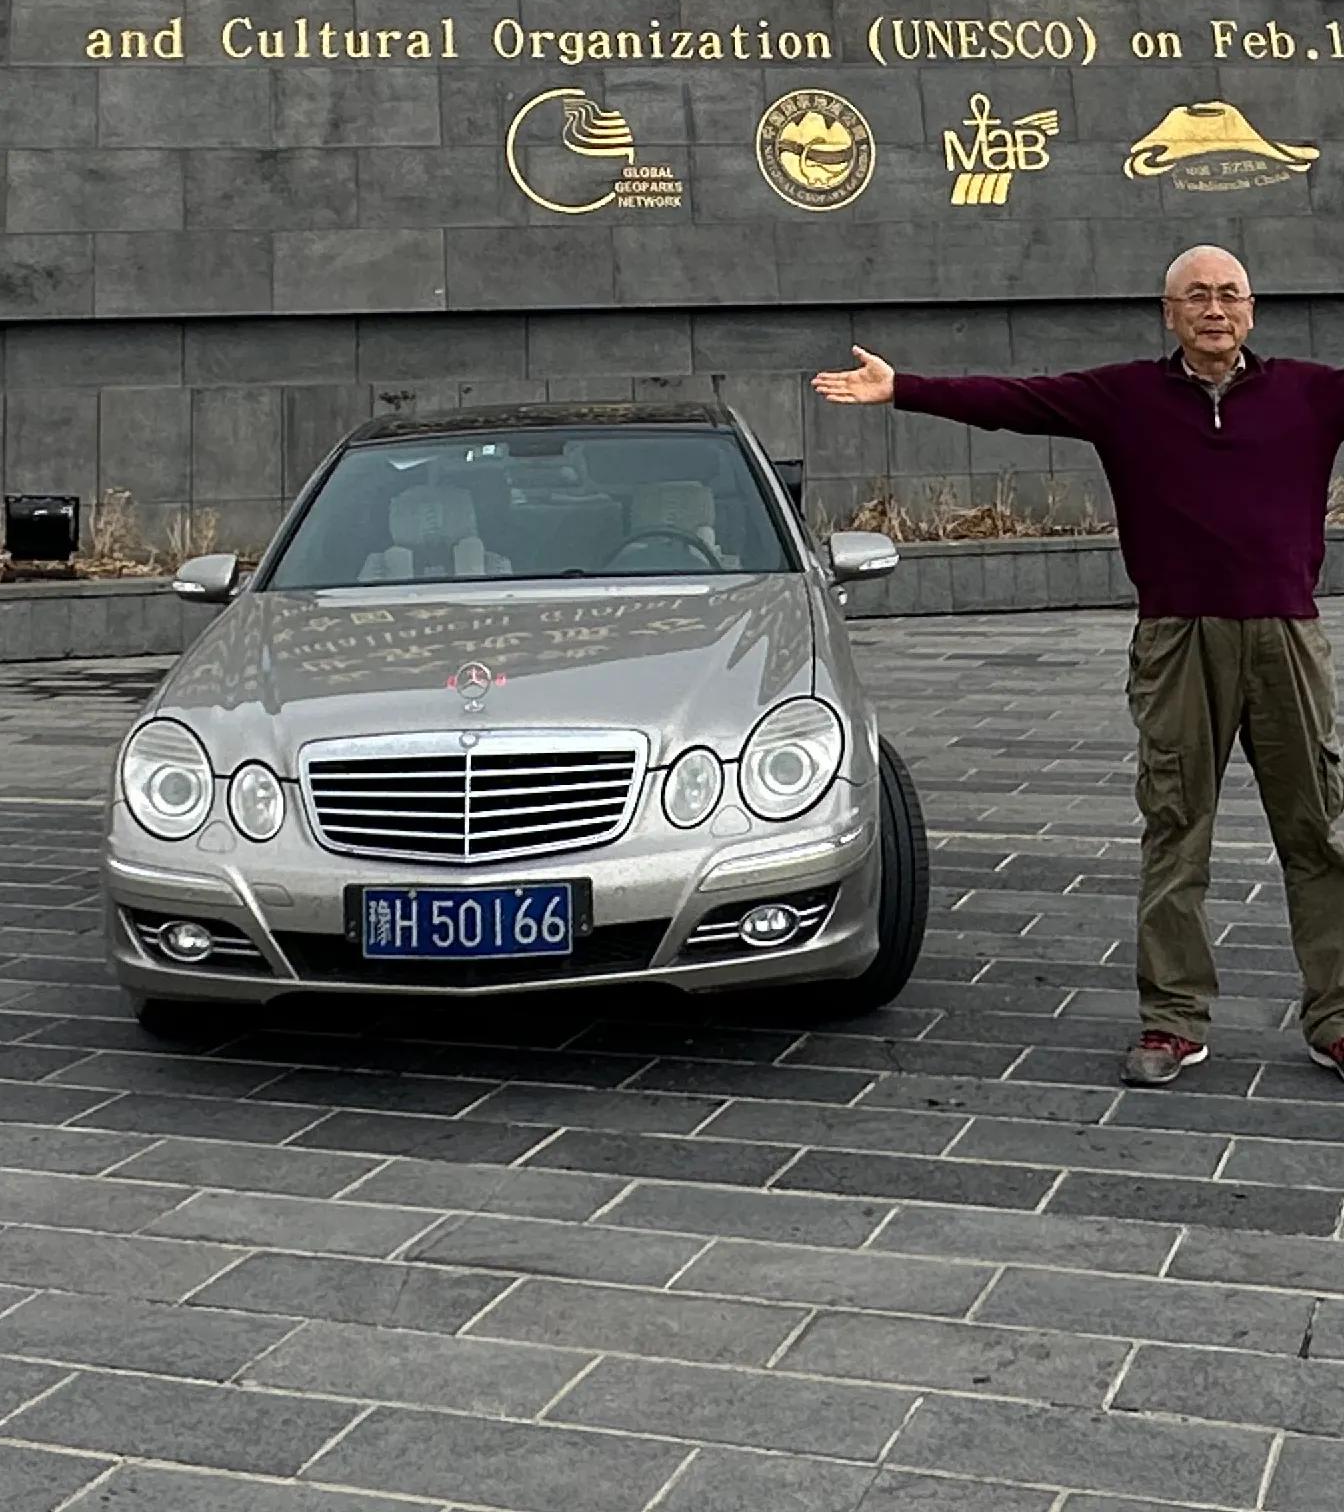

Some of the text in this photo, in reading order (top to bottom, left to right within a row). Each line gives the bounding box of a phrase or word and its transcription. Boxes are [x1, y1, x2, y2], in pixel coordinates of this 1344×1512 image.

[86, 16, 184, 59] and
[222, 16, 459, 58] Cultural
[494, 18, 832, 66] Organization
[868, 16, 1097, 66] (UNESCO)
[1132, 32, 1183, 58] on
[622, 166, 674, 178] GLOBAL
[614, 180, 683, 194] GEOPARKS
[618, 195, 682, 208] NETWORK
[431, 895, 567, 948] 50166
